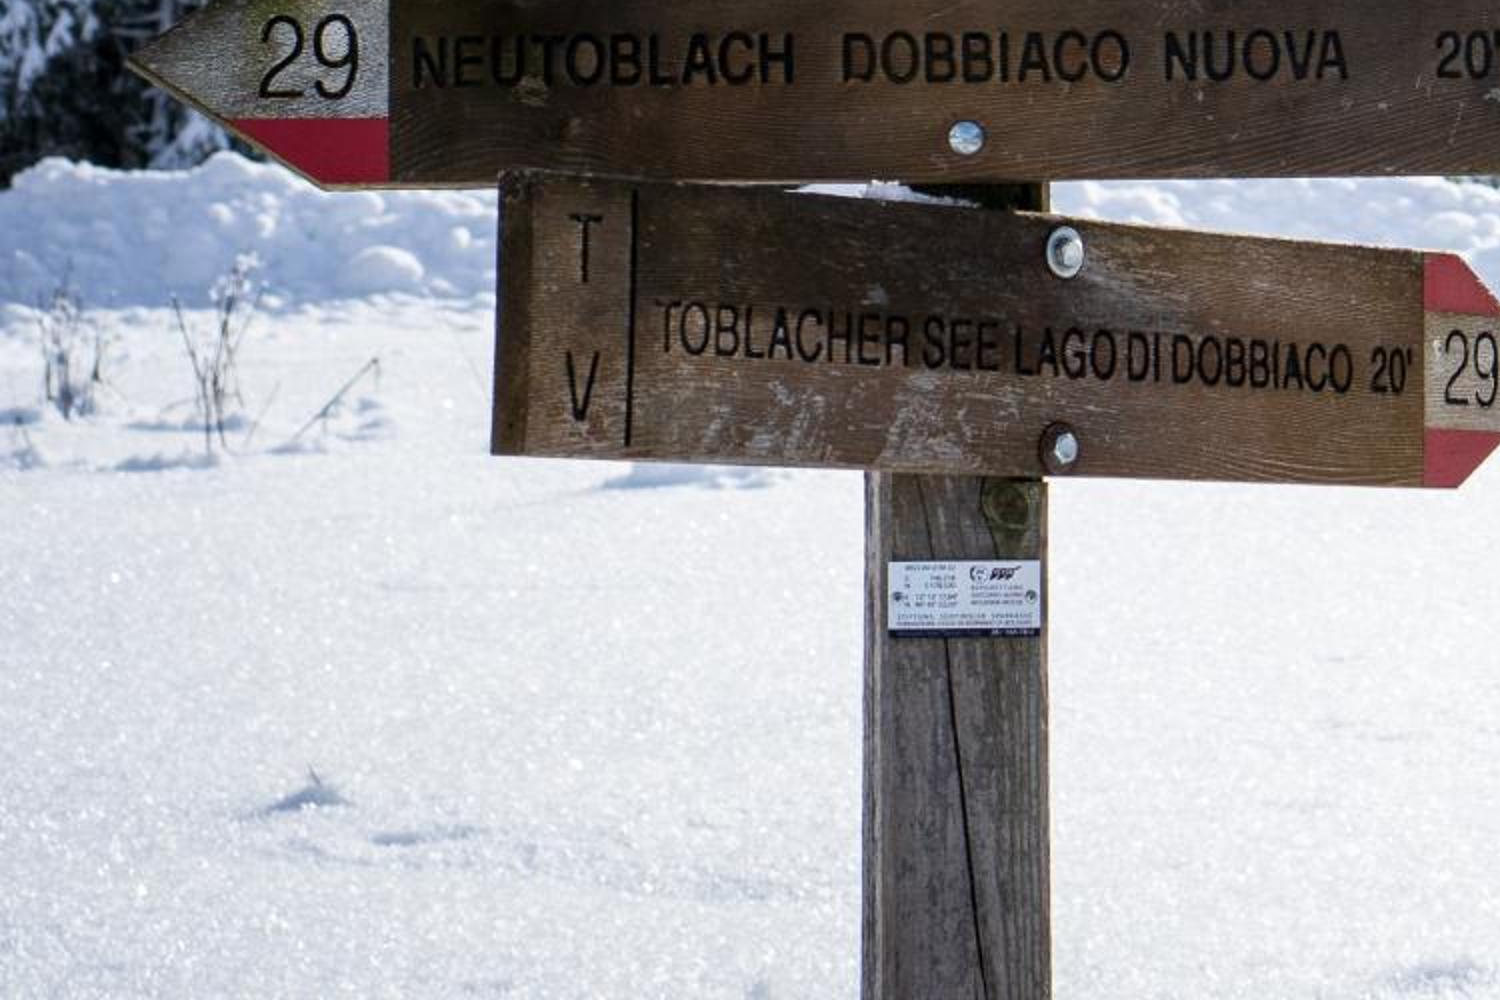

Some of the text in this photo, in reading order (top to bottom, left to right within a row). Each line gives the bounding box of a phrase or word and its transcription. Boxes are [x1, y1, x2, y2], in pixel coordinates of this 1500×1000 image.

[257, 13, 360, 100] 29
[411, 31, 796, 90] NEUTOBLACH
[842, 29, 1130, 84] DOBBIACO
[1164, 28, 1349, 82] NUOVA
[569, 212, 604, 284] T
[654, 301, 910, 368] TOBLACHER
[922, 315, 1000, 371] SEE
[1014, 326, 1117, 383] LAGO
[1126, 330, 1162, 385] DI
[1172, 334, 1353, 394] DOBBIACO
[1443, 329, 1500, 408] 29
[564, 350, 600, 422] V
